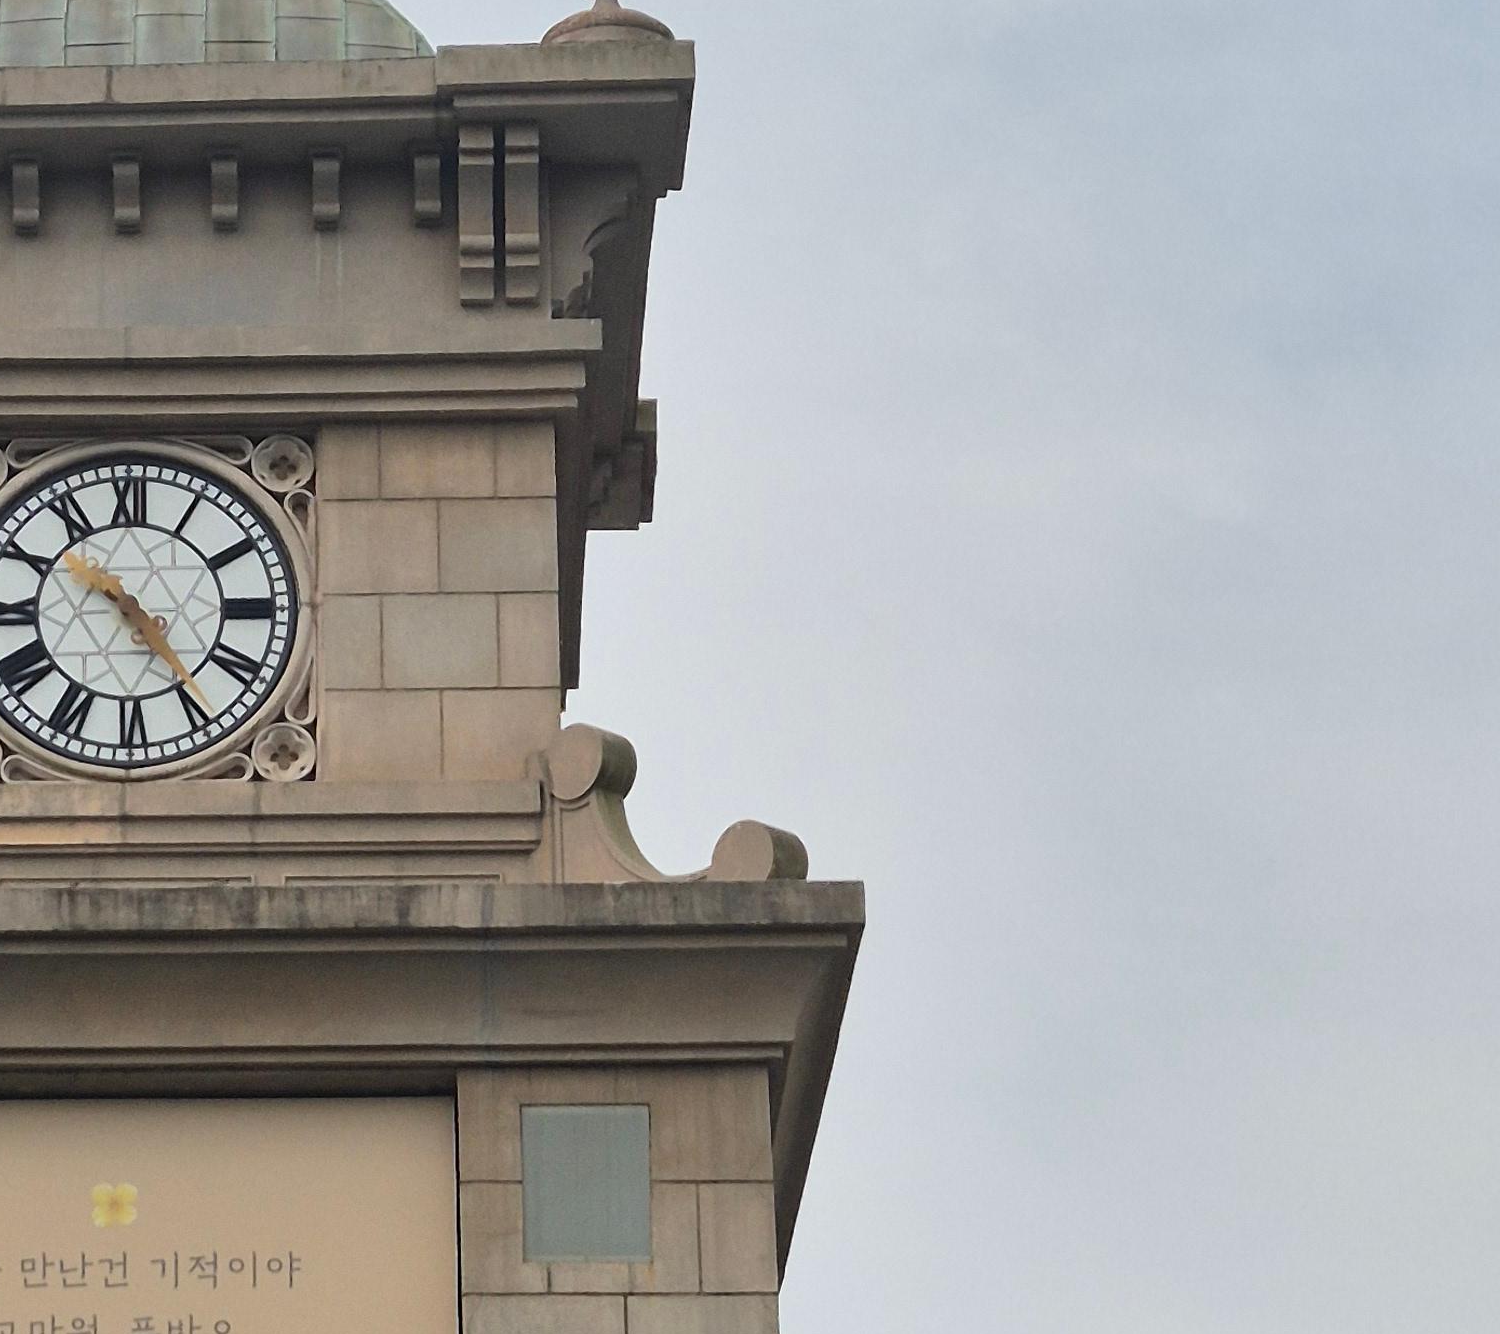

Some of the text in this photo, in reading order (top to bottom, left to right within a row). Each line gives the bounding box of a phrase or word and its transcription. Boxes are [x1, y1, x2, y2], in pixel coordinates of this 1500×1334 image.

[49, 496, 94, 542] XI
[111, 479, 147, 526] XII
[174, 496, 202, 534] I
[2, 540, 50, 576] X
[50, 683, 95, 736] VII
[119, 700, 148, 745] VI
[176, 686, 210, 728] V
[20, 1250, 131, 1289] 만난건
[150, 1249, 303, 1289] 기적이야
